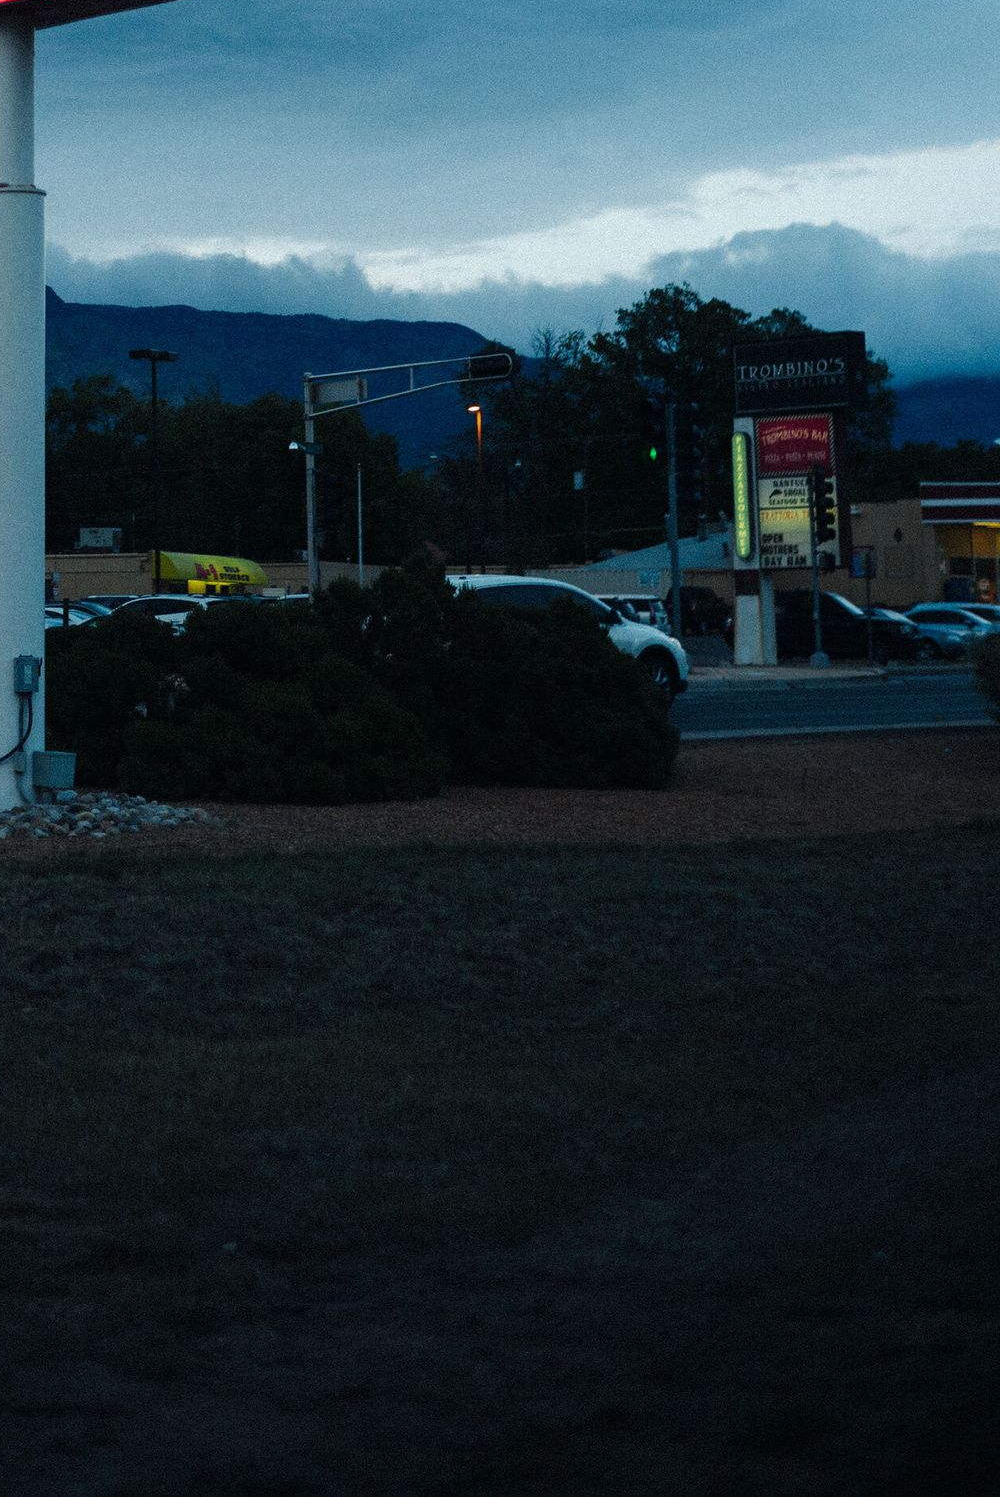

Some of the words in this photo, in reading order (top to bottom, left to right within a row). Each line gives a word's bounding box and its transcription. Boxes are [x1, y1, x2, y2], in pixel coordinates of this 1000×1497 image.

[737, 357, 845, 380] TROMBINO'S
[772, 479, 808, 488] NANTUC
[783, 488, 807, 498] SHOAL
[762, 534, 783, 543] OPEN
